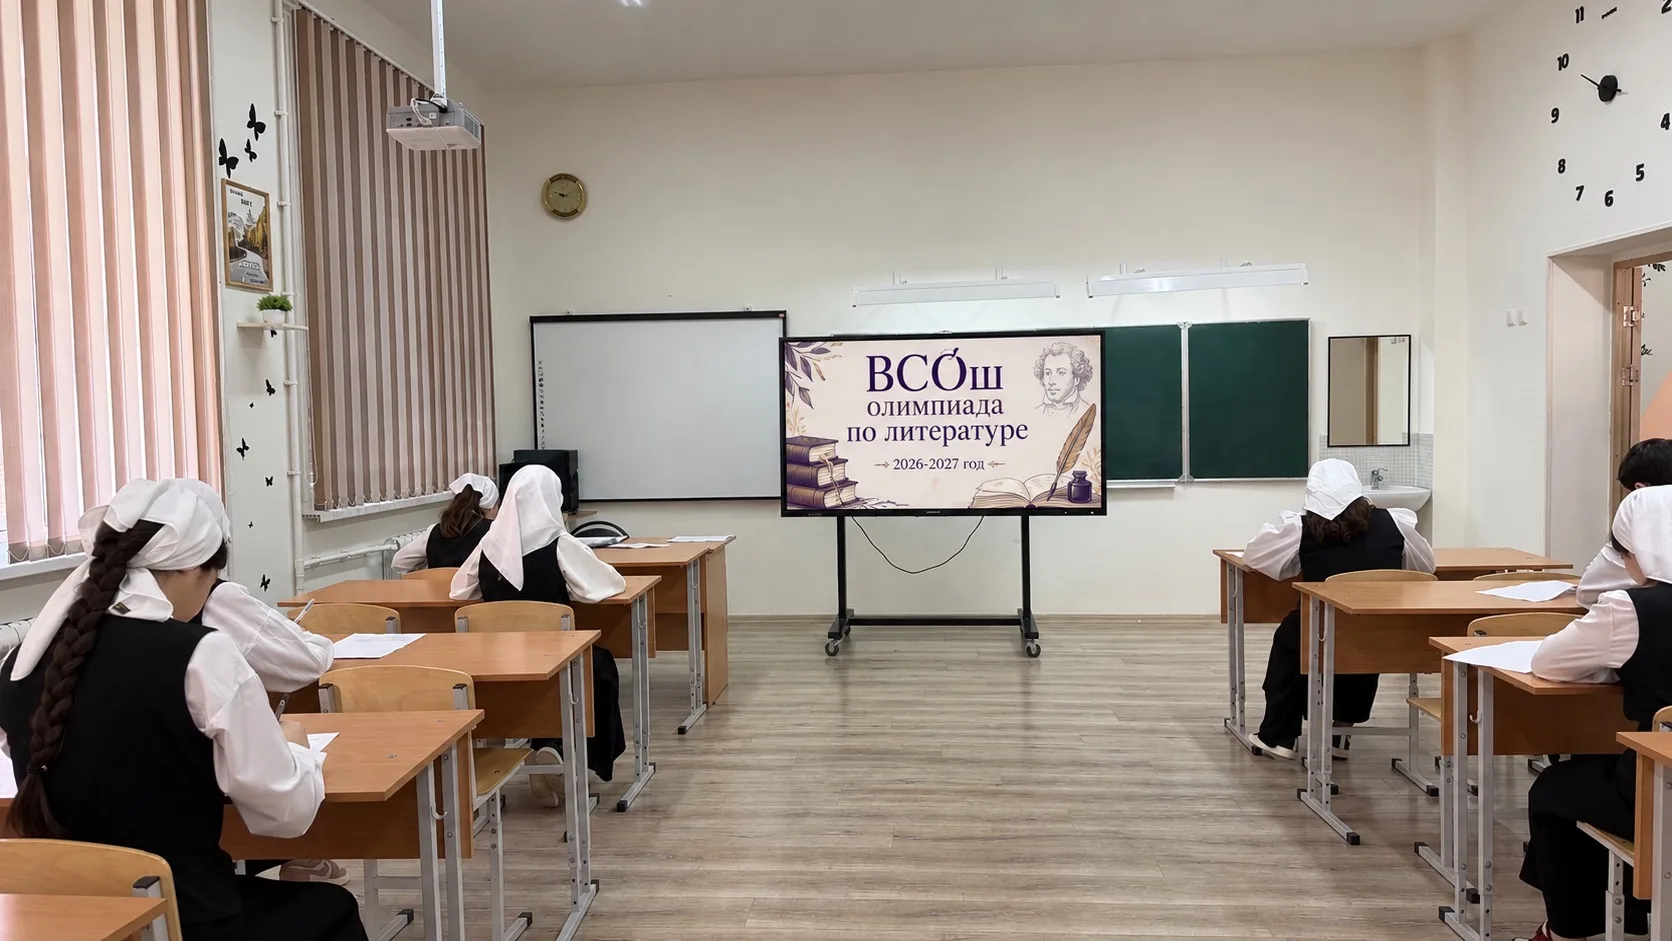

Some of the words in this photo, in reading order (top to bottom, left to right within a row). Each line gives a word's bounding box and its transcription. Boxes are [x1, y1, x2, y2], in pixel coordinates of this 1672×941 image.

[1574, 5, 1585, 24] 11
[1556, 53, 1570, 71] 10
[1550, 107, 1560, 124] 9
[1660, 112, 1671, 131] 4
[1557, 158, 1566, 174] 8
[1635, 163, 1645, 182] 5
[1575, 184, 1585, 202] 7
[1604, 189, 1614, 207] 6
[866, 398, 1005, 418] олимпиада
[847, 426, 877, 442] по
[884, 423, 1029, 447] литературе
[893, 458, 960, 470] 2026-2027
[963, 460, 986, 471] год
